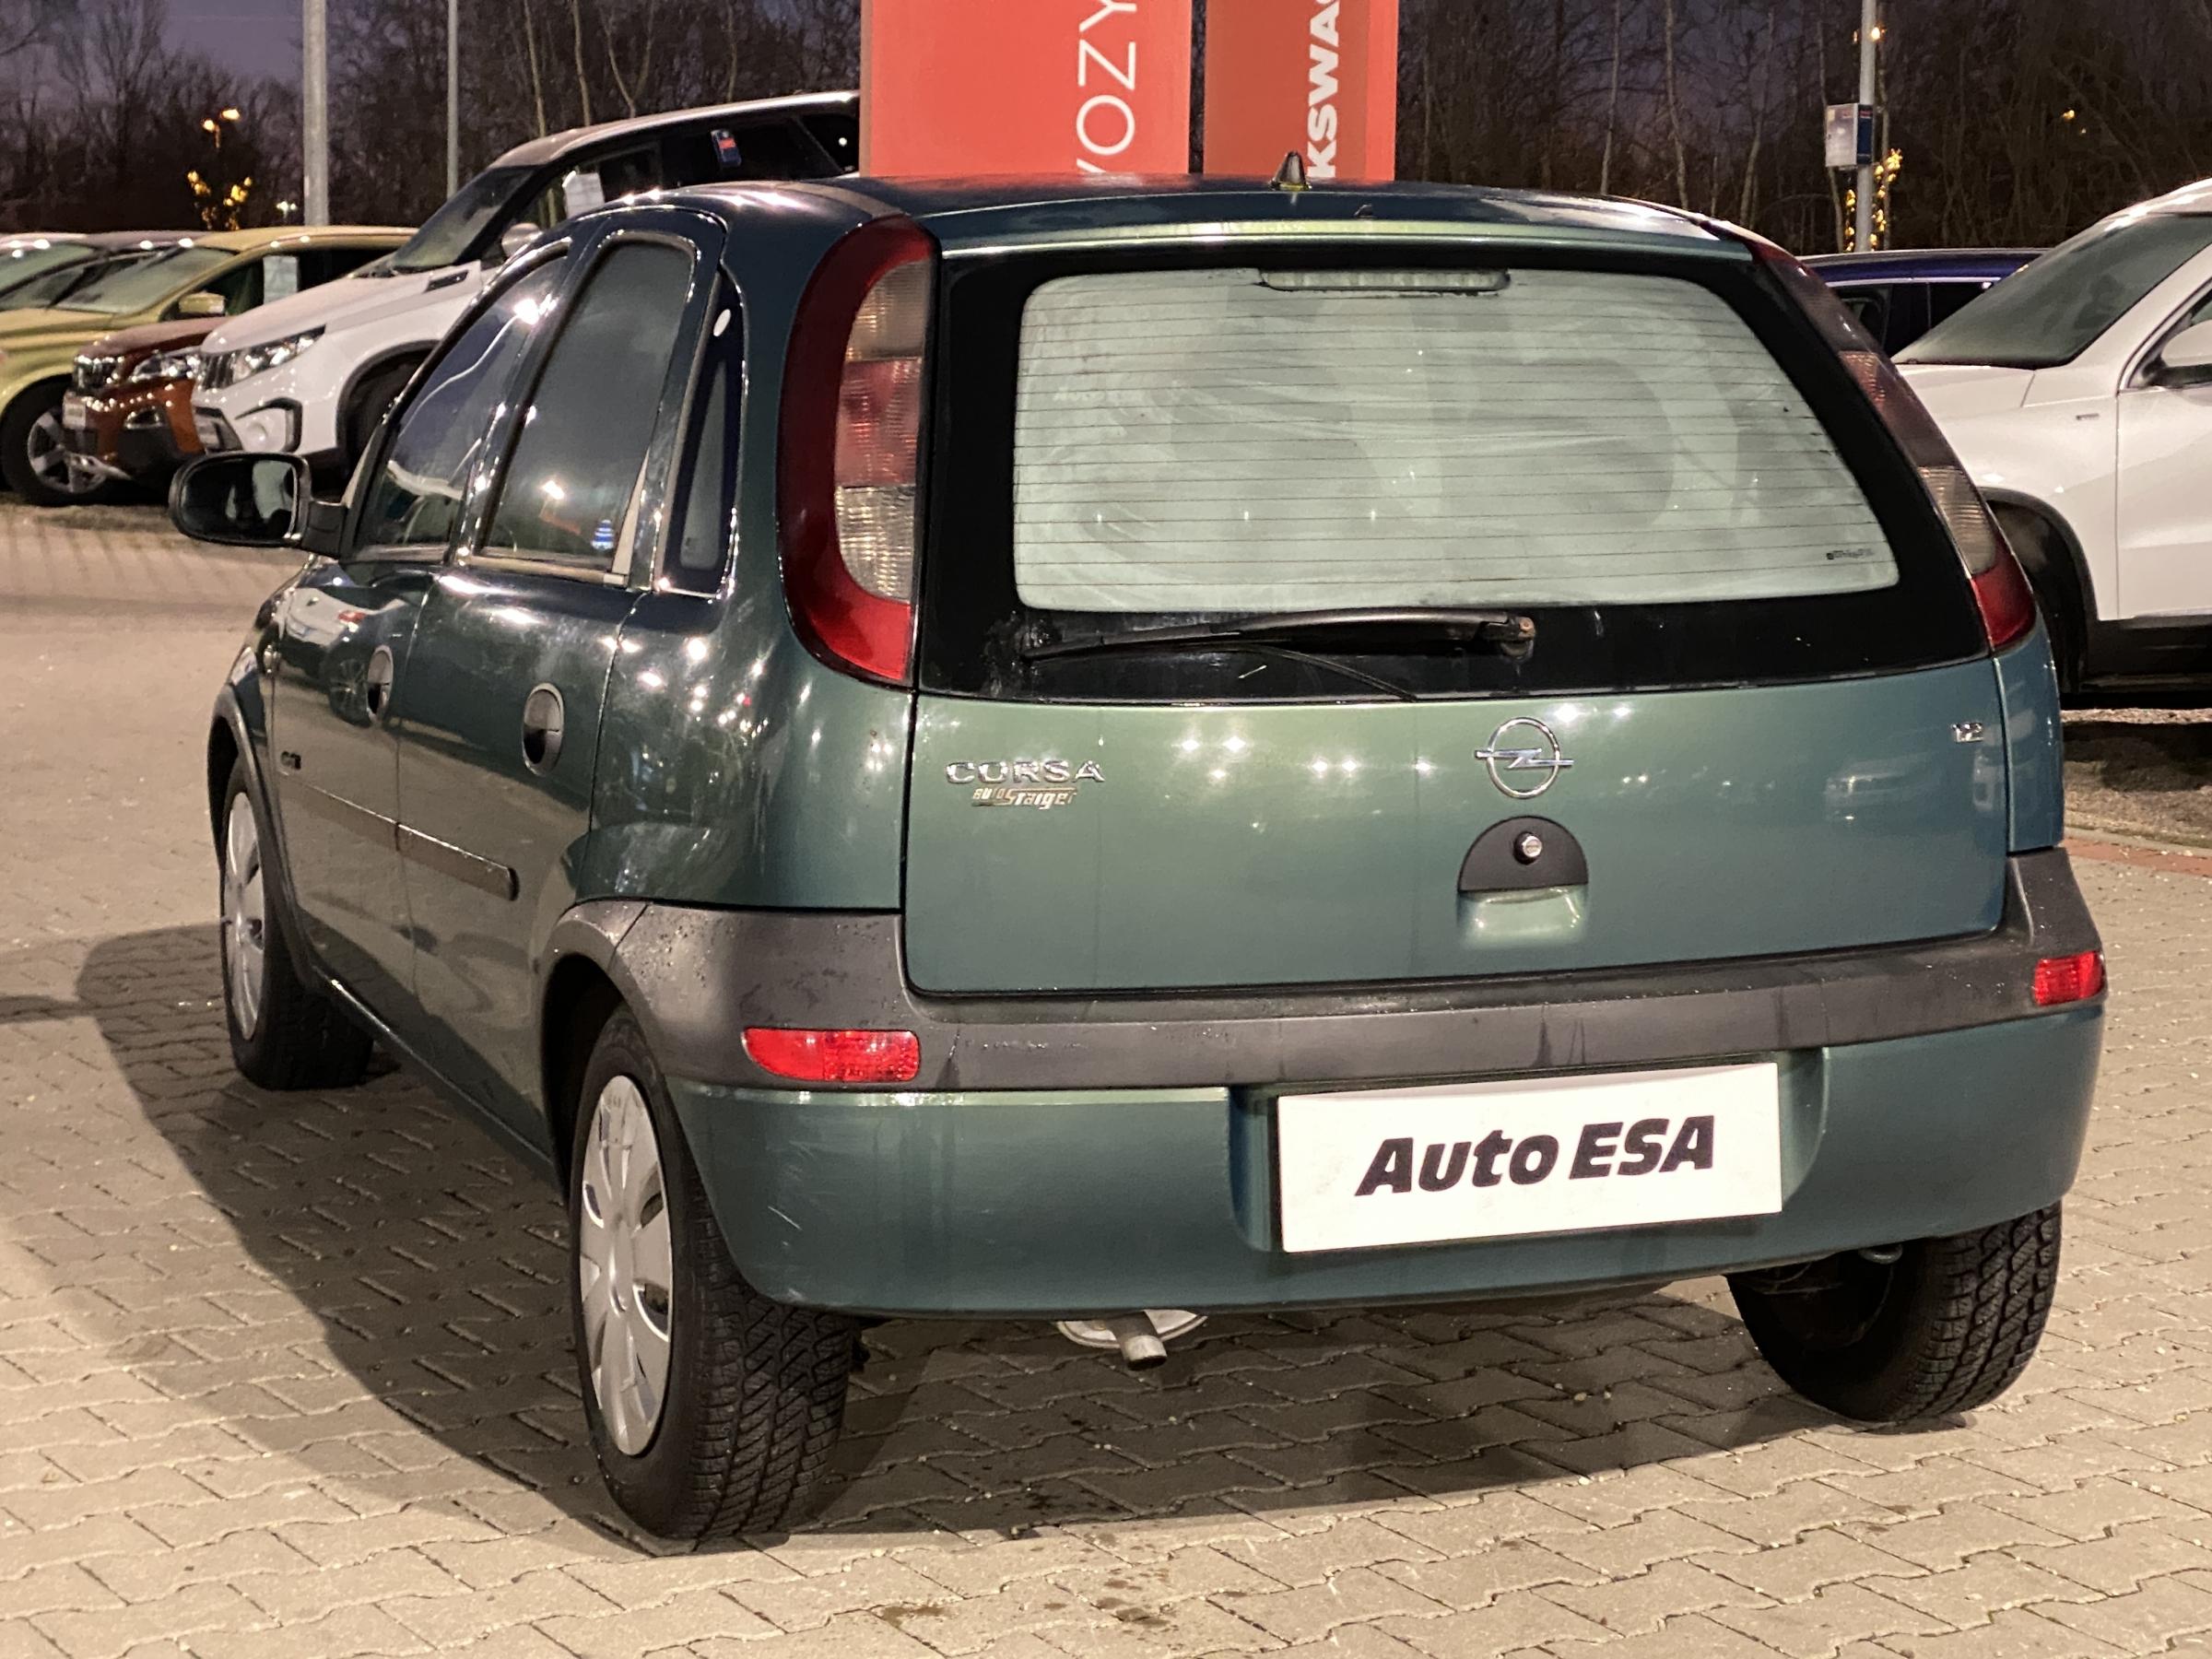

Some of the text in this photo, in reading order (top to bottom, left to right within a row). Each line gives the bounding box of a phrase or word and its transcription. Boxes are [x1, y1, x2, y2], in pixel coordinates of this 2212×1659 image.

[1307, 0, 1340, 178] KSWA
[946, 759, 1105, 783] CORSA
[1354, 1115, 1714, 1196] Auto ESA
